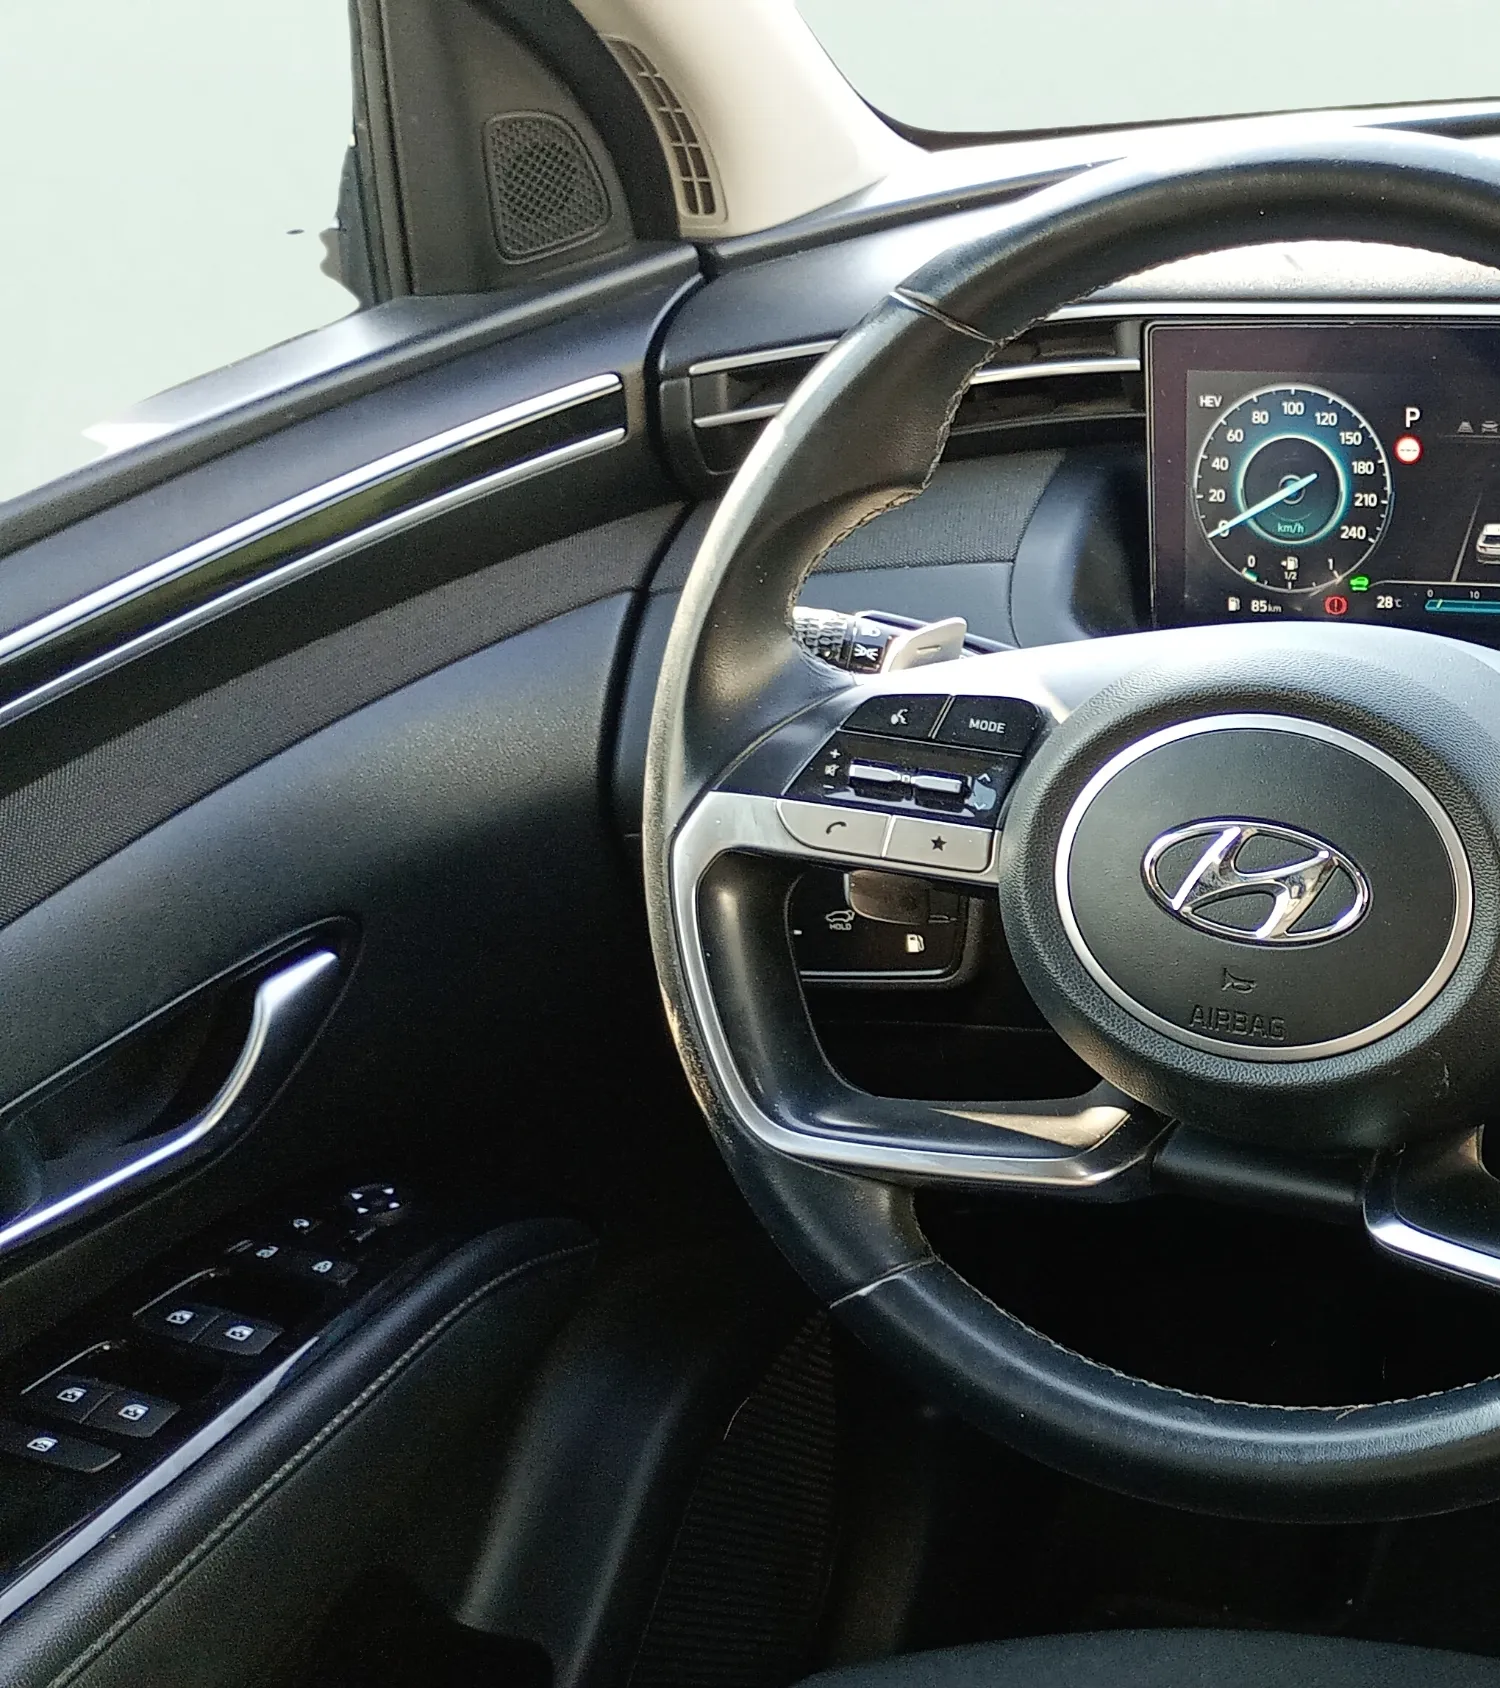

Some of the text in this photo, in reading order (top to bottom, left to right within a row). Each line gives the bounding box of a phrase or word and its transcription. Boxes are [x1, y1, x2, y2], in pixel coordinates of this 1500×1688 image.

[1200, 395, 1222, 408] HEV
[1282, 402, 1304, 415] 100
[1252, 411, 1269, 424] 80
[1315, 412, 1338, 426] 120
[1405, 407, 1421, 428] P
[1226, 429, 1244, 442] 60
[1339, 432, 1362, 445] 150
[1211, 458, 1229, 471] 40
[1352, 461, 1374, 474] 180
[1208, 489, 1226, 502] 20
[1354, 494, 1377, 507] 210
[1277, 522, 1304, 533] km/h
[1340, 526, 1366, 539] 240
[1247, 556, 1256, 568] 0
[1327, 558, 1334, 570] 1
[1284, 571, 1297, 580] 1/2
[1427, 589, 1434, 598] 0
[1469, 590, 1480, 599] 10
[969, 718, 1006, 734] MODE
[1189, 1005, 1288, 1041] AIRBAG
